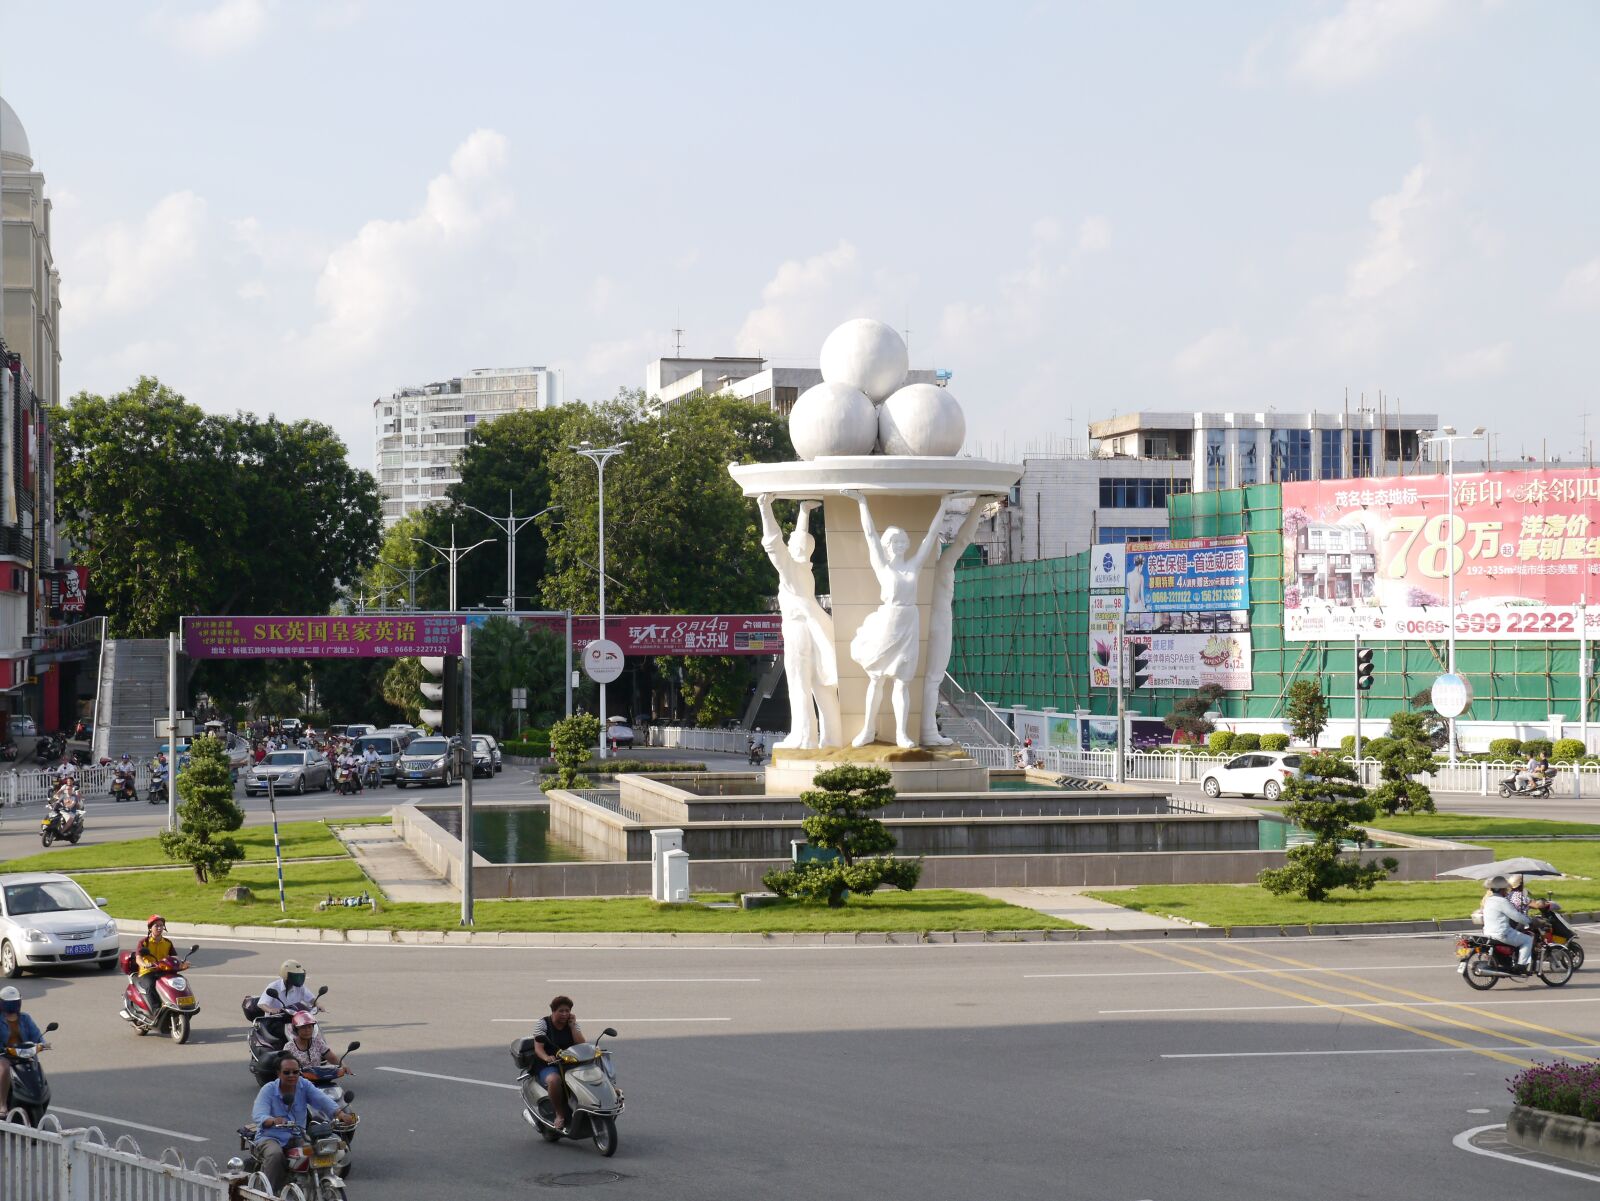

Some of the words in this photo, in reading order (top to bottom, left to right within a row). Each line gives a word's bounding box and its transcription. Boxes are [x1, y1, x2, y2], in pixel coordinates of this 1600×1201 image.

[1335, 488, 1418, 507] 茂名生态地标
[1520, 514, 1590, 538] 洋房价
[254, 620, 417, 643] SK英国皇家英语
[1506, 611, 1575, 633] 2222
[685, 631, 729, 649] 盛大开业
